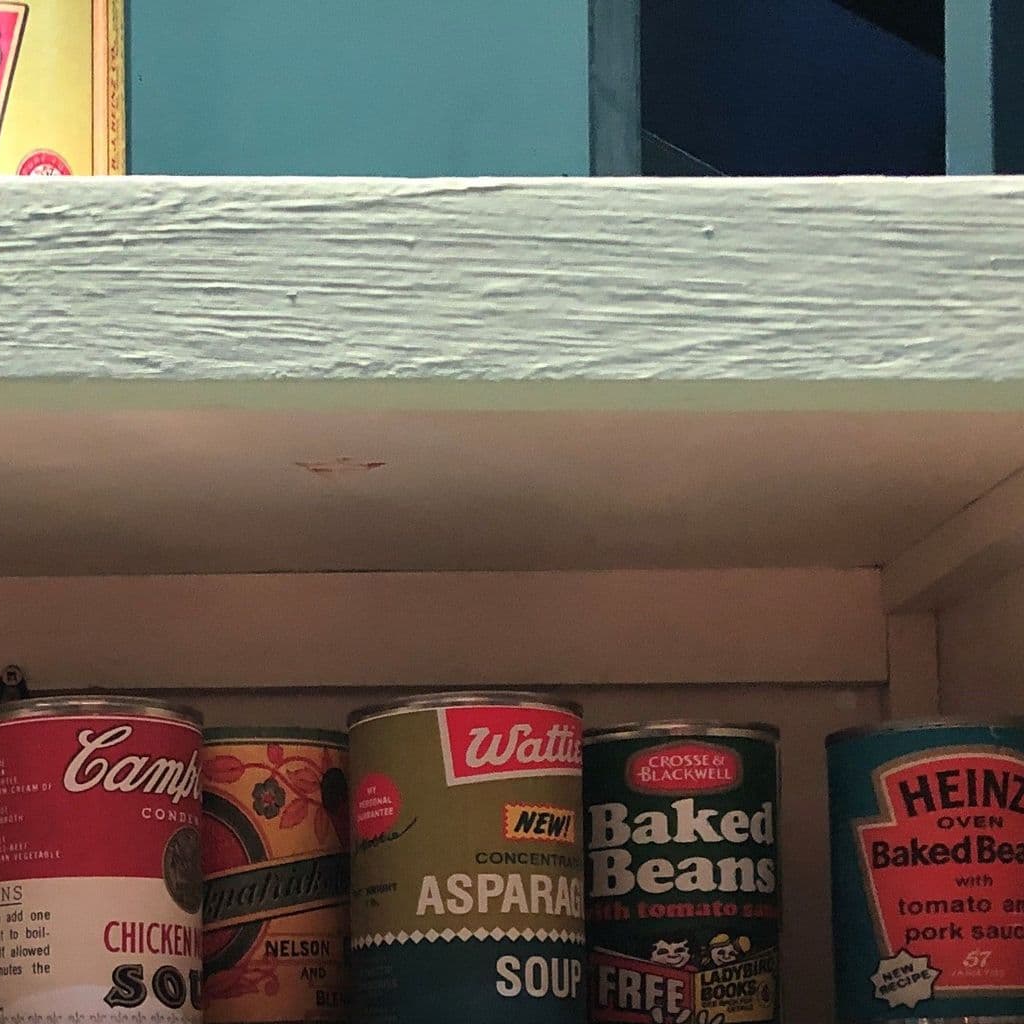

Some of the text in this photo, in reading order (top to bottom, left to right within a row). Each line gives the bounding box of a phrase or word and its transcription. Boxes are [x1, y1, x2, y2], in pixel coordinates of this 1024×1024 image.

[648, 754, 724, 768] CROSSE &
[637, 767, 732, 782] BLACKWELL
[898, 768, 1024, 818] HEINZ
[514, 811, 570, 838] NEW!
[589, 798, 774, 848] Baked
[937, 815, 1004, 829] OVEN
[872, 836, 971, 869] Baked
[590, 849, 776, 896] Beans
[956, 874, 993, 888] with
[638, 902, 738, 918] tomato
[899, 896, 992, 916] tomato
[6, 910, 23, 923] add
[30, 911, 50, 922] one
[10, 928, 18, 940] to
[26, 926, 50, 938] boil-
[104, 920, 192, 956] CHICKEN
[905, 922, 963, 945] pork
[10, 944, 50, 958] allowed
[265, 940, 330, 957] NELSON
[32, 962, 50, 974] the
[962, 950, 992, 968] 57
[300, 968, 326, 980] AND
[496, 956, 581, 998] SOUP
[882, 963, 914, 983] NEW
[598, 965, 684, 1014] FREE
[701, 980, 756, 1000] BOOKS
[878, 970, 931, 997] RECIPE
